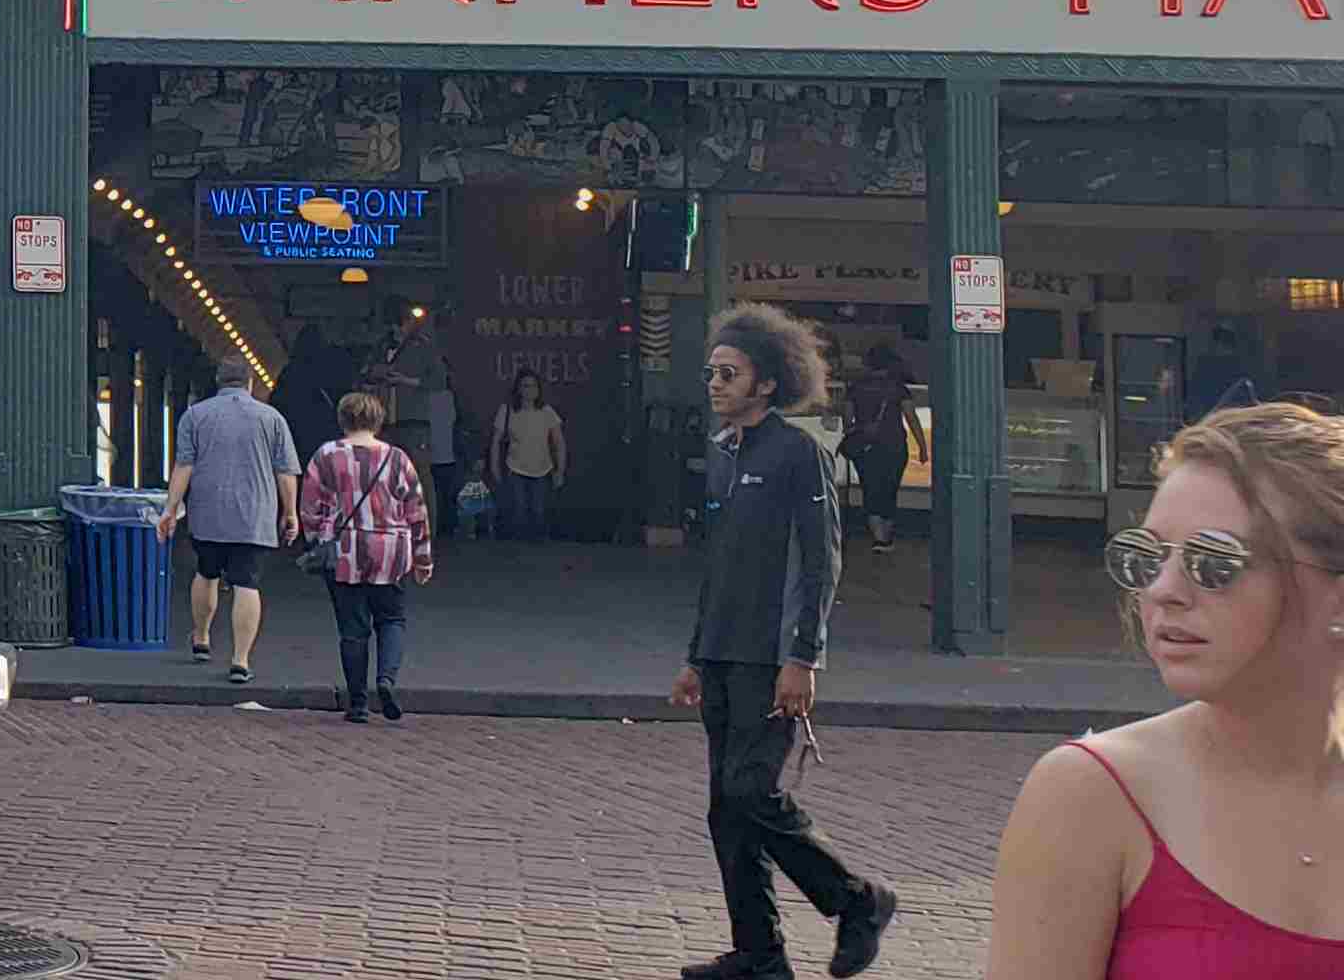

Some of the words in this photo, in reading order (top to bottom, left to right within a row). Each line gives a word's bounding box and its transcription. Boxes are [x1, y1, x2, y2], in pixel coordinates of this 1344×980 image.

[210, 187, 430, 218] WATERONT
[16, 219, 32, 231] NO
[240, 221, 401, 246] VIEWPOINT
[21, 234, 58, 248] STOPS
[275, 245, 318, 258] PUBLIC
[320, 247, 376, 259] SEATING
[954, 258, 970, 271] NO
[959, 274, 998, 288] STOPS
[496, 272, 586, 307] LOWER
[496, 348, 593, 382] LEVELS
